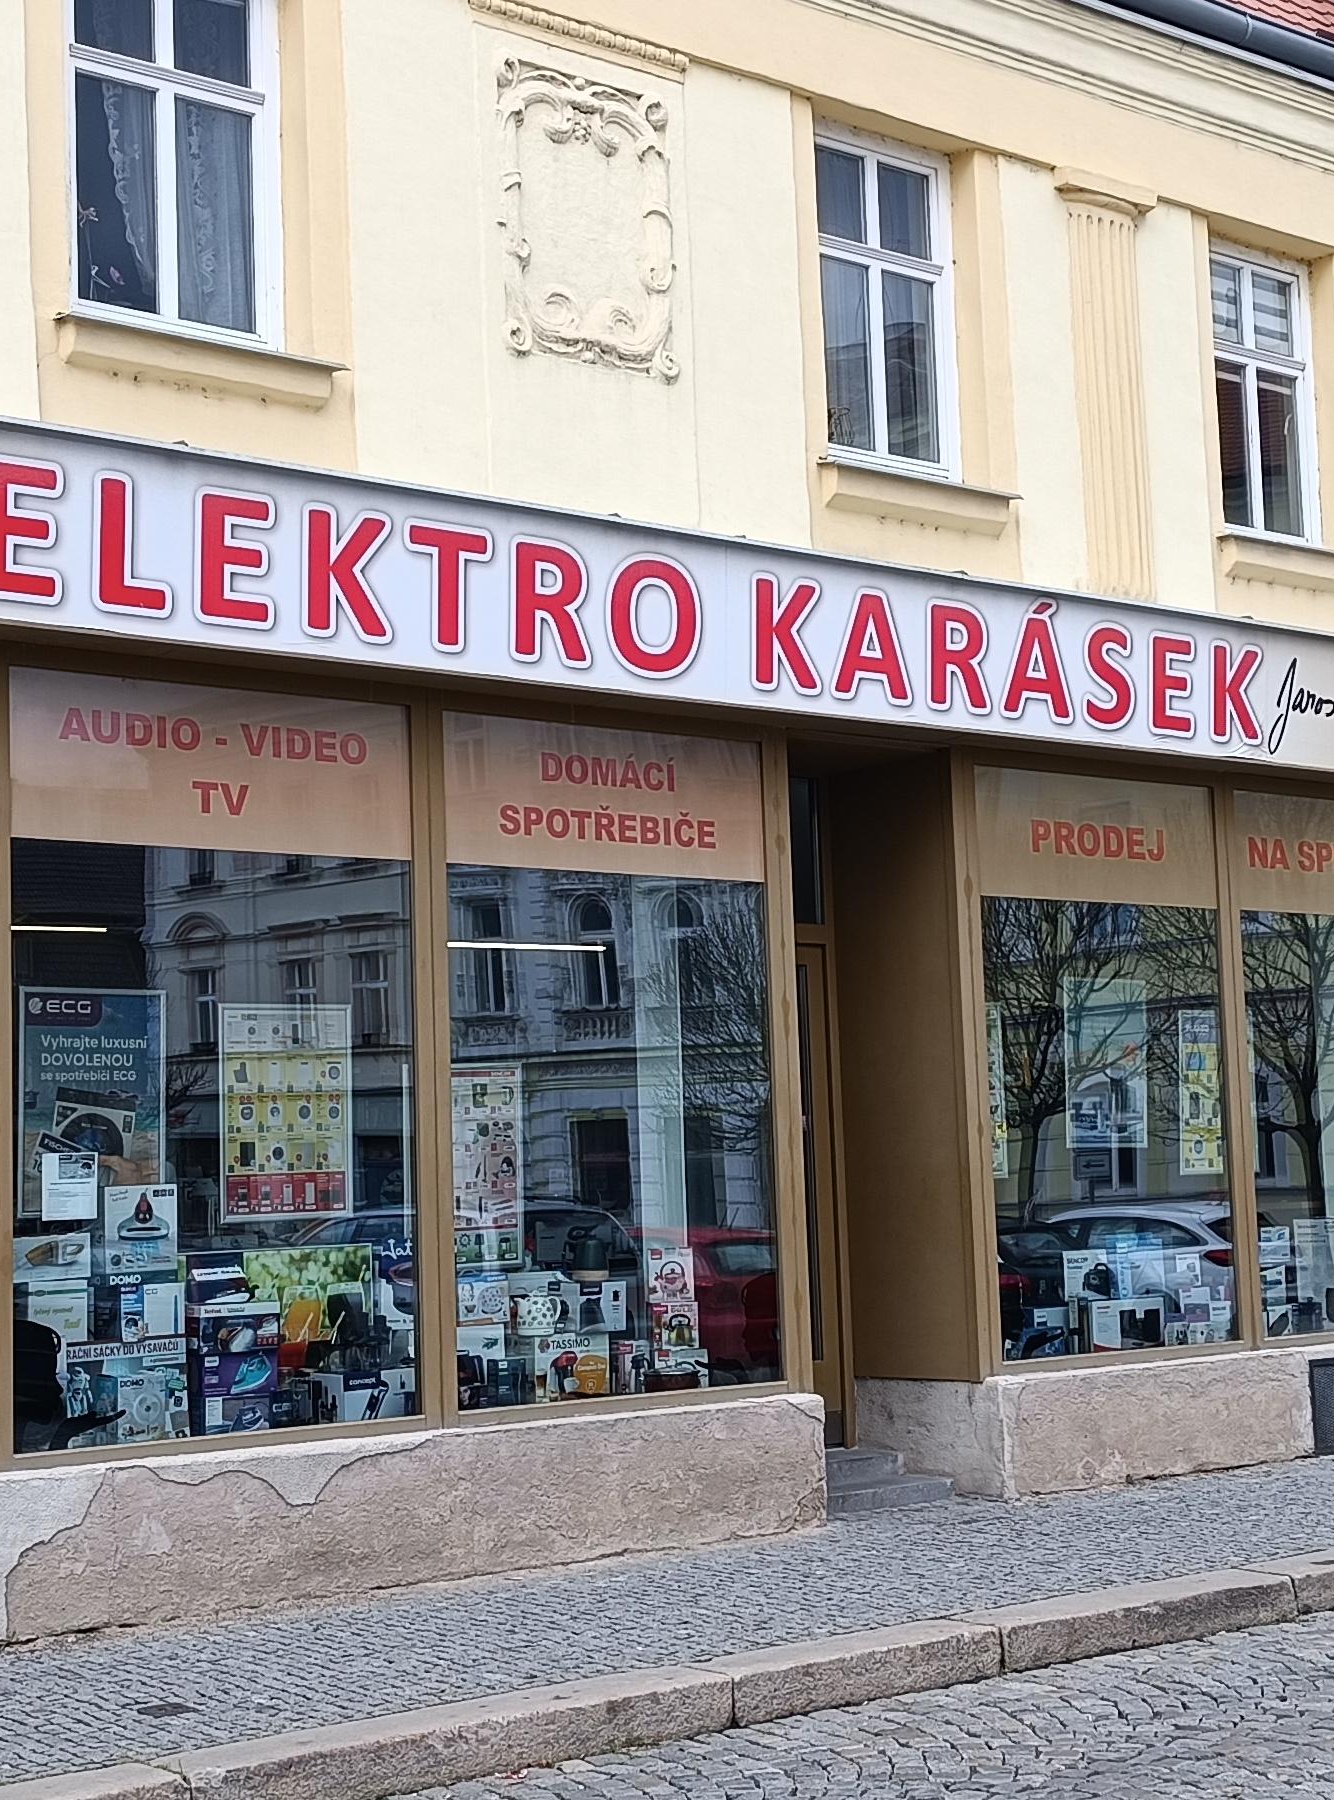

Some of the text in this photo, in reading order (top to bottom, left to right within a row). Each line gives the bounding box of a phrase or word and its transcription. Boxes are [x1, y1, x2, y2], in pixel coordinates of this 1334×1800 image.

[751, 571, 1265, 747] KARÁSEK
[59, 707, 201, 752] AUDIO
[240, 724, 368, 766] VIDEO
[540, 751, 676, 793] DOMÁCÍ
[192, 780, 249, 816] TV
[499, 804, 717, 850] SPOTŘEBIČE
[1030, 819, 1165, 862] PRODEJ
[1247, 836, 1290, 870] NA
[46, 1000, 92, 1014] ECG
[40, 1034, 148, 1051] Vyhrajte luxusní
[41, 1053, 133, 1067] DOVOLENOU
[40, 1071, 53, 1081] se
[113, 1070, 137, 1081] ECG
[109, 1274, 142, 1286] DOMO
[124, 1345, 136, 1356] DO
[550, 1337, 591, 1350] TASSIMO
[119, 1378, 145, 1388] DOMO
